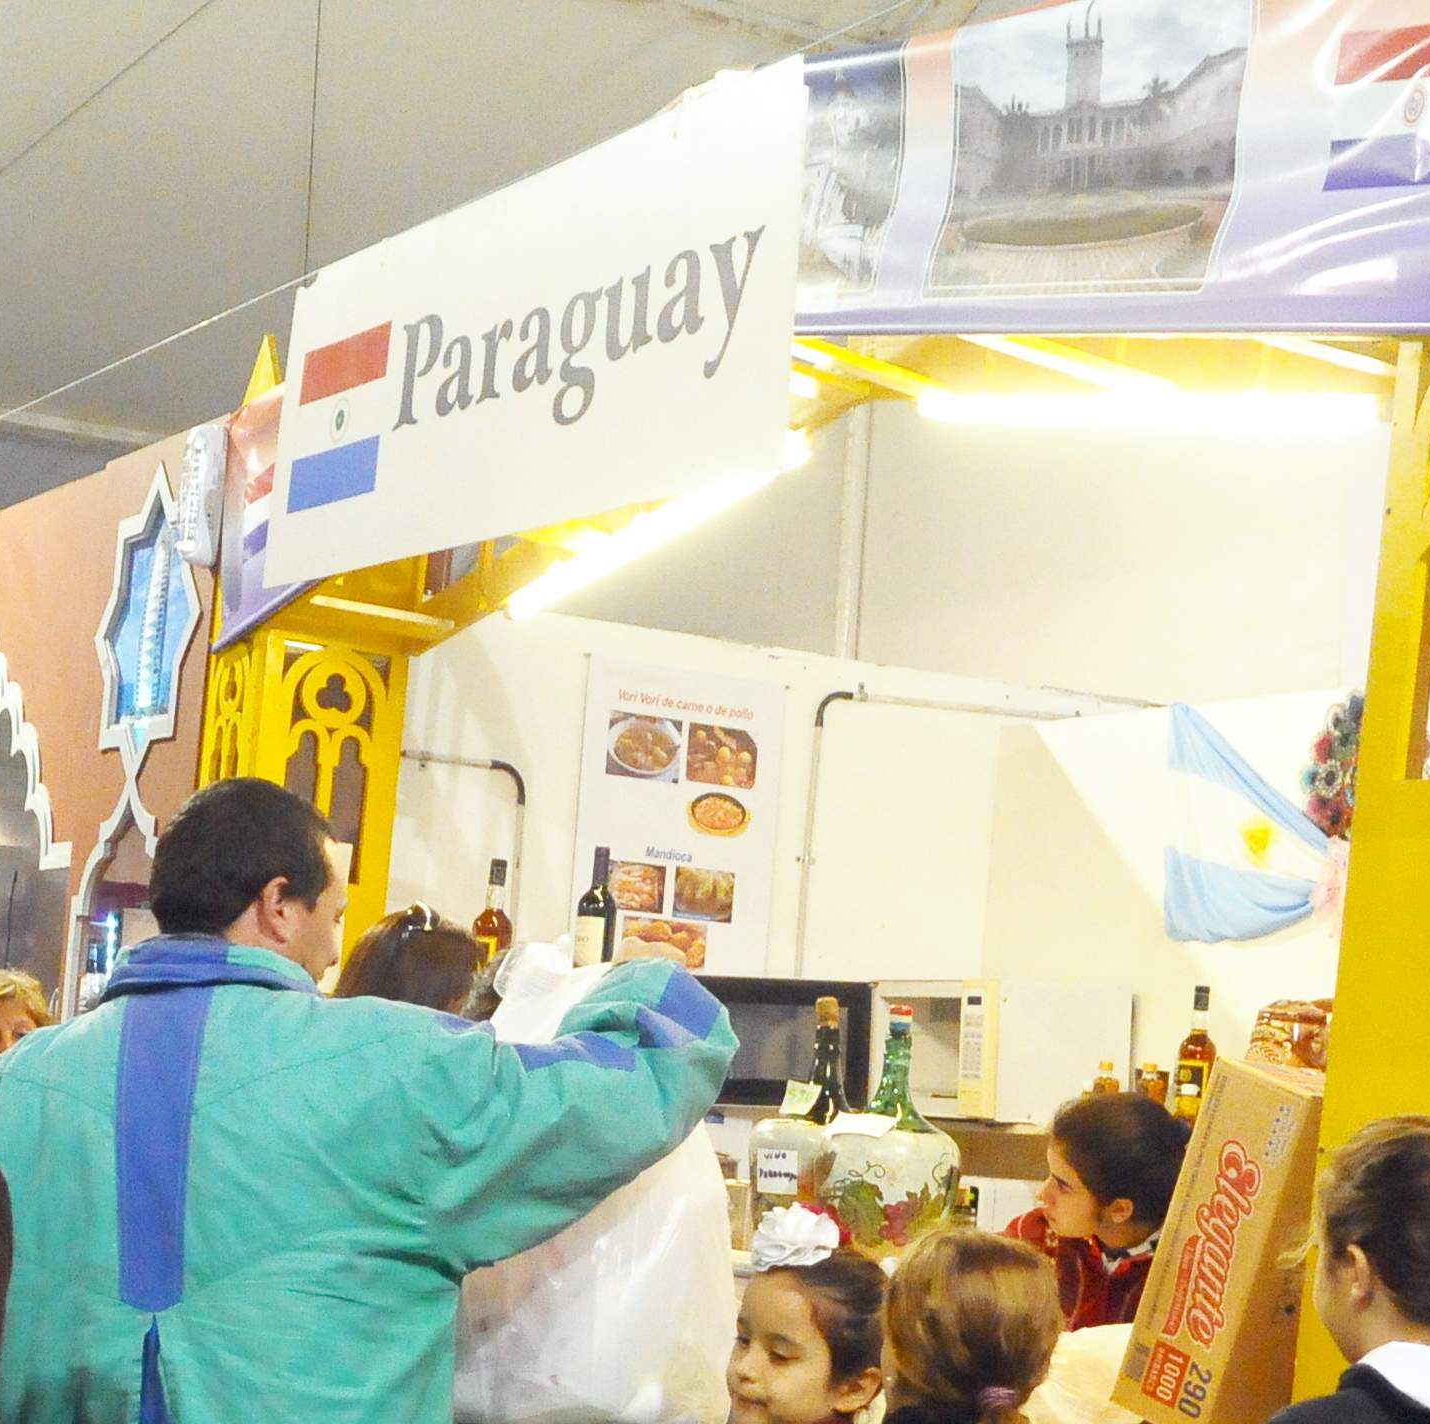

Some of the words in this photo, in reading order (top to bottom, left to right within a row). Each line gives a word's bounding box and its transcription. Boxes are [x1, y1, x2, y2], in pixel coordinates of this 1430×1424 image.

[392, 224, 766, 432] Paraguay
[618, 688, 638, 701] Vori
[639, 692, 660, 705] Vori
[661, 696, 675, 708] de
[676, 701, 704, 713] carne
[714, 703, 727, 716] de
[728, 705, 754, 720] pollo
[645, 845, 693, 863] Mandioca
[1186, 1139, 1262, 1346] Elegante
[1156, 1353, 1184, 1402] 1000
[1178, 1360, 1213, 1420] 290
